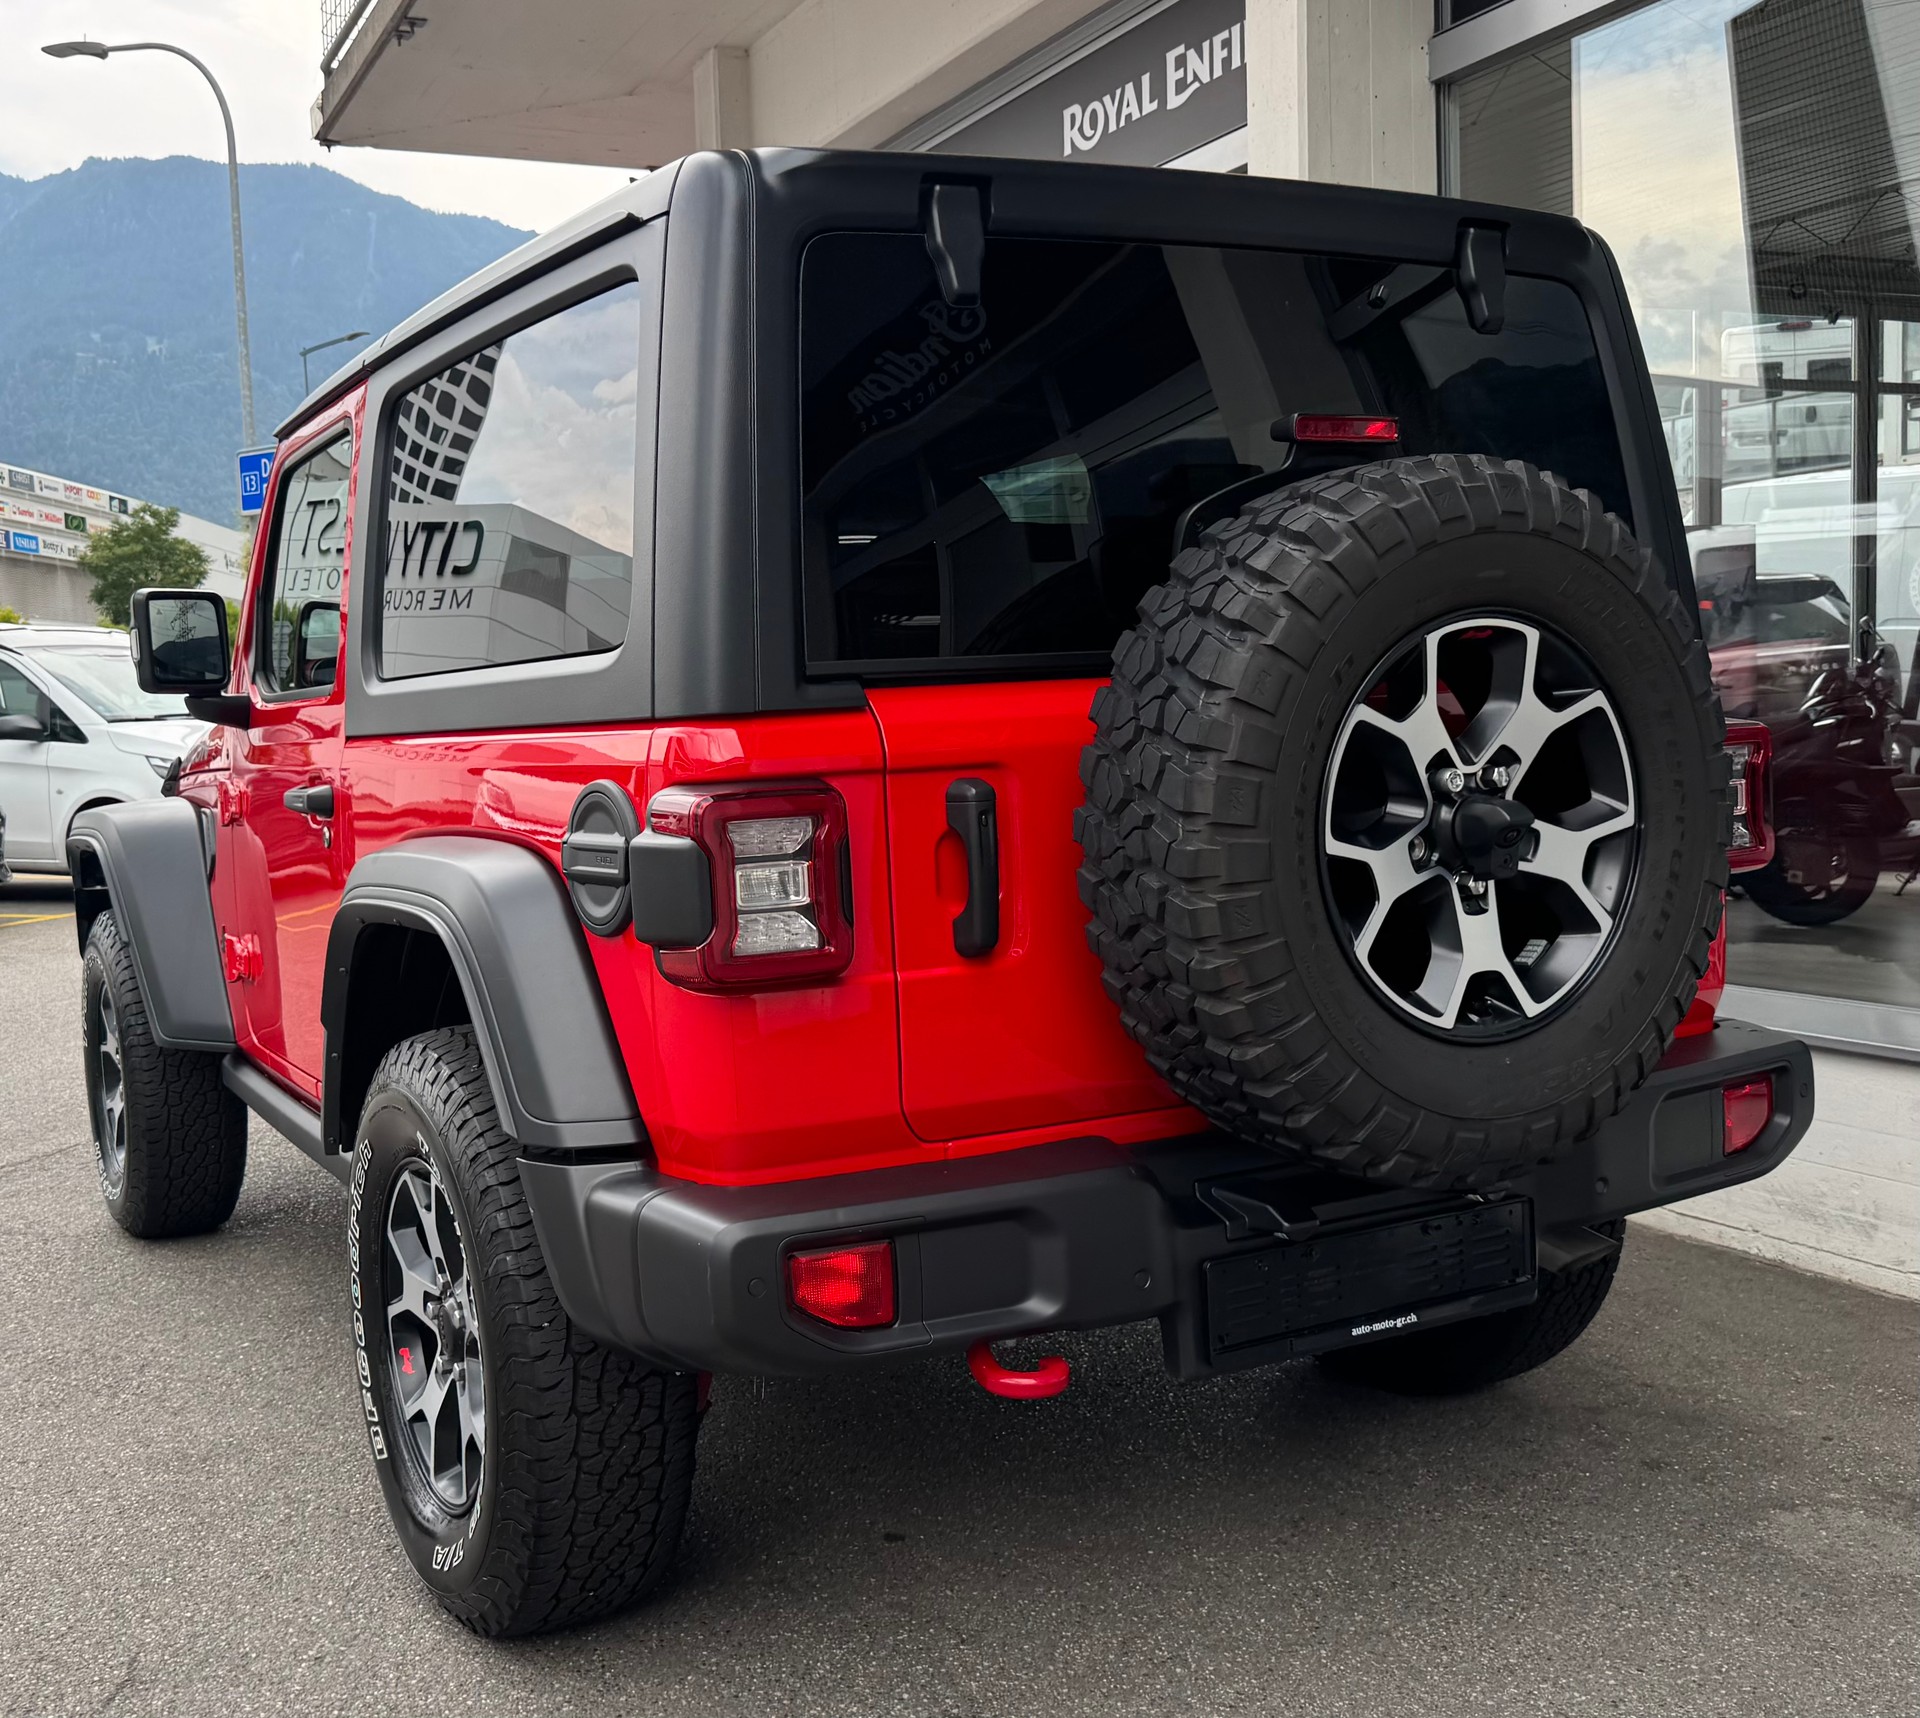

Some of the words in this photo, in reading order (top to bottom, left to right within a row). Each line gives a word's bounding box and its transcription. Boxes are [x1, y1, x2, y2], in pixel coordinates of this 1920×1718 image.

[1063, 72, 1158, 157] ROYAL
[1166, 19, 1247, 110] ENFI
[261, 458, 273, 478] D
[245, 474, 257, 492] 13
[348, 1138, 389, 1461] BFGoodrich
[1351, 1312, 1418, 1336] auto-moto-gr.ch
